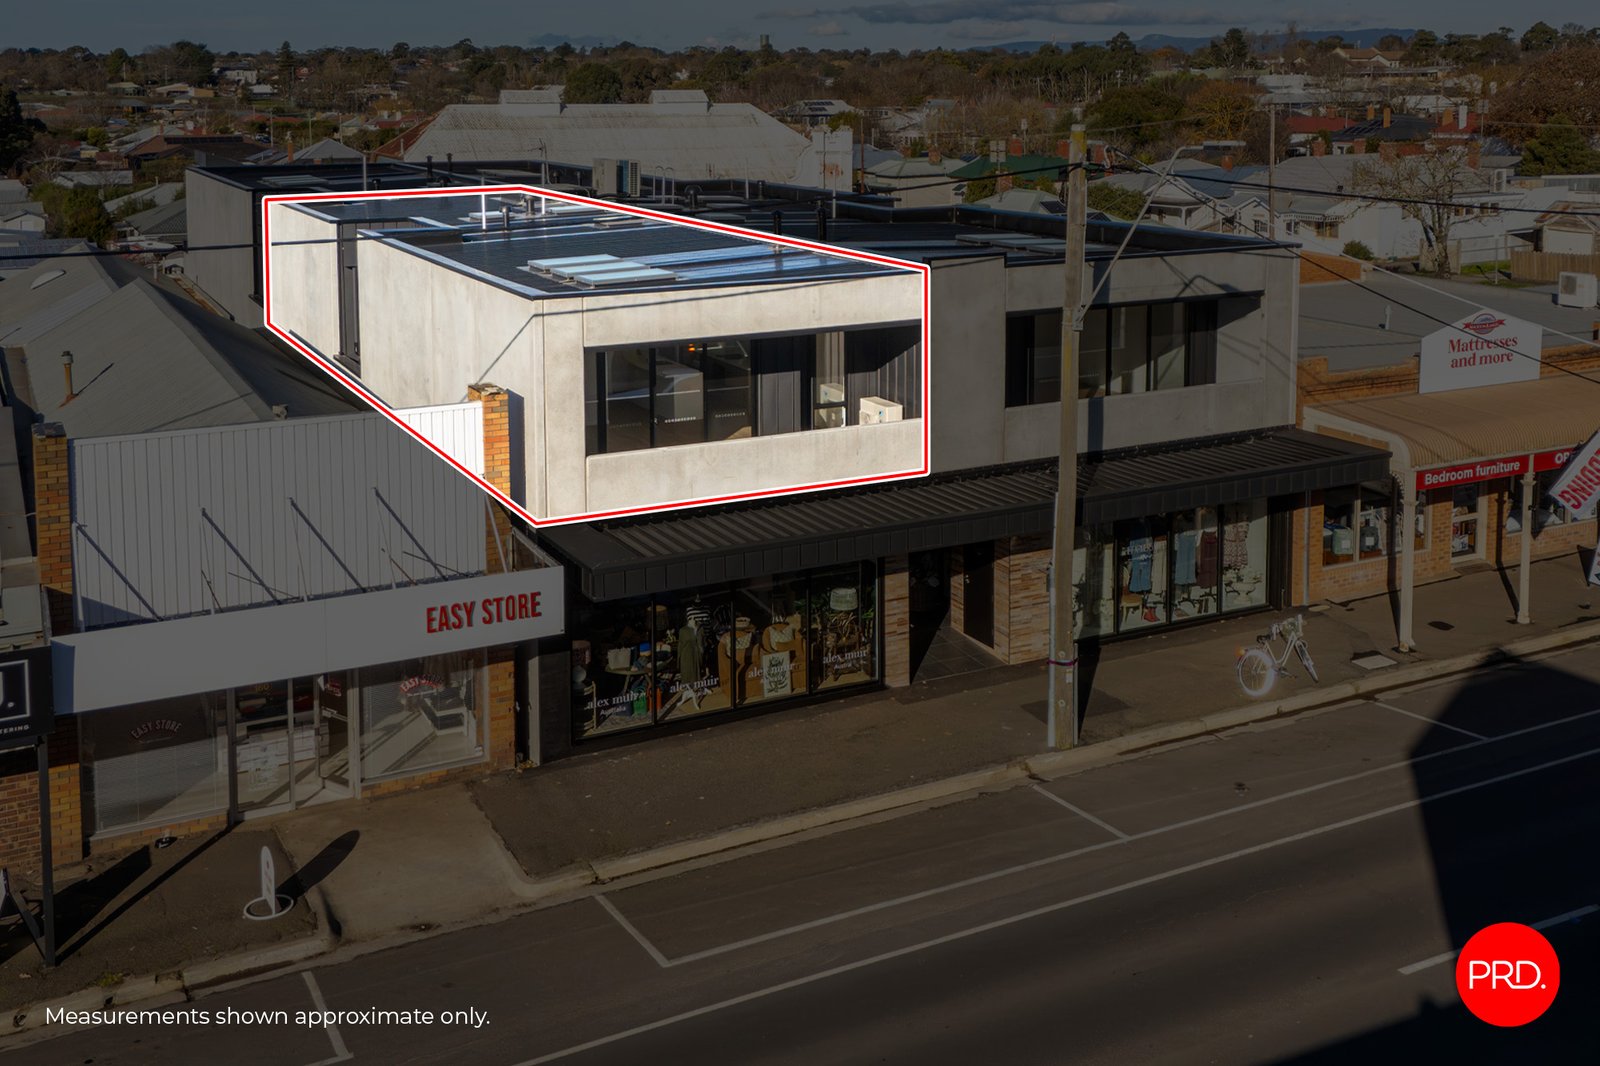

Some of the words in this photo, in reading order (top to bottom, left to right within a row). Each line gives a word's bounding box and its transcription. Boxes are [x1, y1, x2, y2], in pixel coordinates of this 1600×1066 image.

[1449, 336, 1518, 353] Mattresses
[1451, 352, 1476, 368] and
[1479, 350, 1513, 364] more
[1424, 467, 1473, 485] Bedroom
[1476, 460, 1520, 477] furniture
[426, 601, 475, 633] EASY
[482, 591, 542, 624] STORE
[823, 652, 843, 664] alex
[693, 674, 719, 689] muir
[131, 720, 153, 739] EASY
[155, 719, 182, 732] STORE
